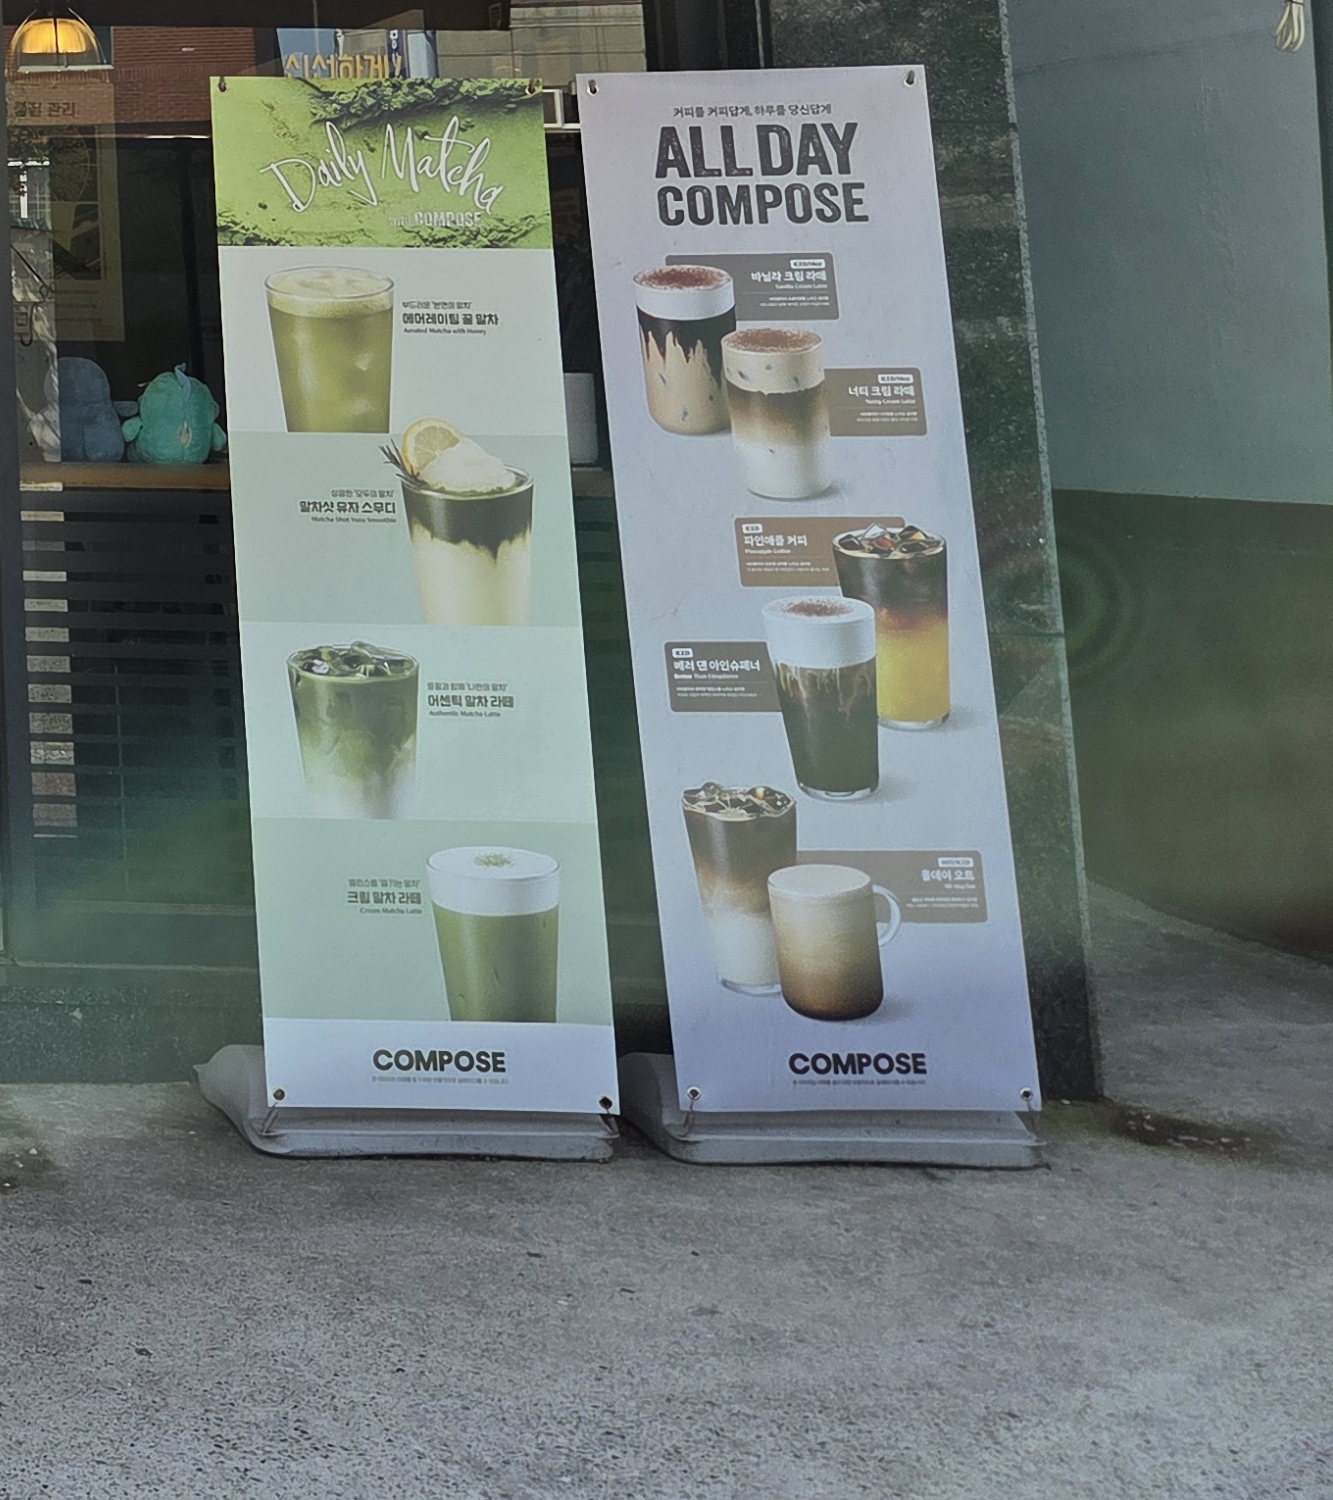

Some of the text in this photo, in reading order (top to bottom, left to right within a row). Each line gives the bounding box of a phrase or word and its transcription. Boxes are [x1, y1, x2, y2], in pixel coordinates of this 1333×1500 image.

[673, 106, 704, 118] 커피를
[754, 104, 786, 116] 하루를
[788, 103, 832, 116] 당신답게
[655, 122, 858, 179] ALL DAY
[259, 115, 505, 214] Daily Matcha
[656, 182, 869, 226] COMPOSE
[414, 211, 482, 227] COMPOSE
[475, 313, 499, 325] 말차
[336, 501, 360, 513] 유자
[361, 501, 396, 514] 스무디
[744, 534, 808, 546] 파인애플 커피
[464, 695, 488, 708] 말차
[372, 891, 396, 904] 말차
[372, 1049, 506, 1073] COMPOSE
[789, 1053, 927, 1075] COMPOSE
